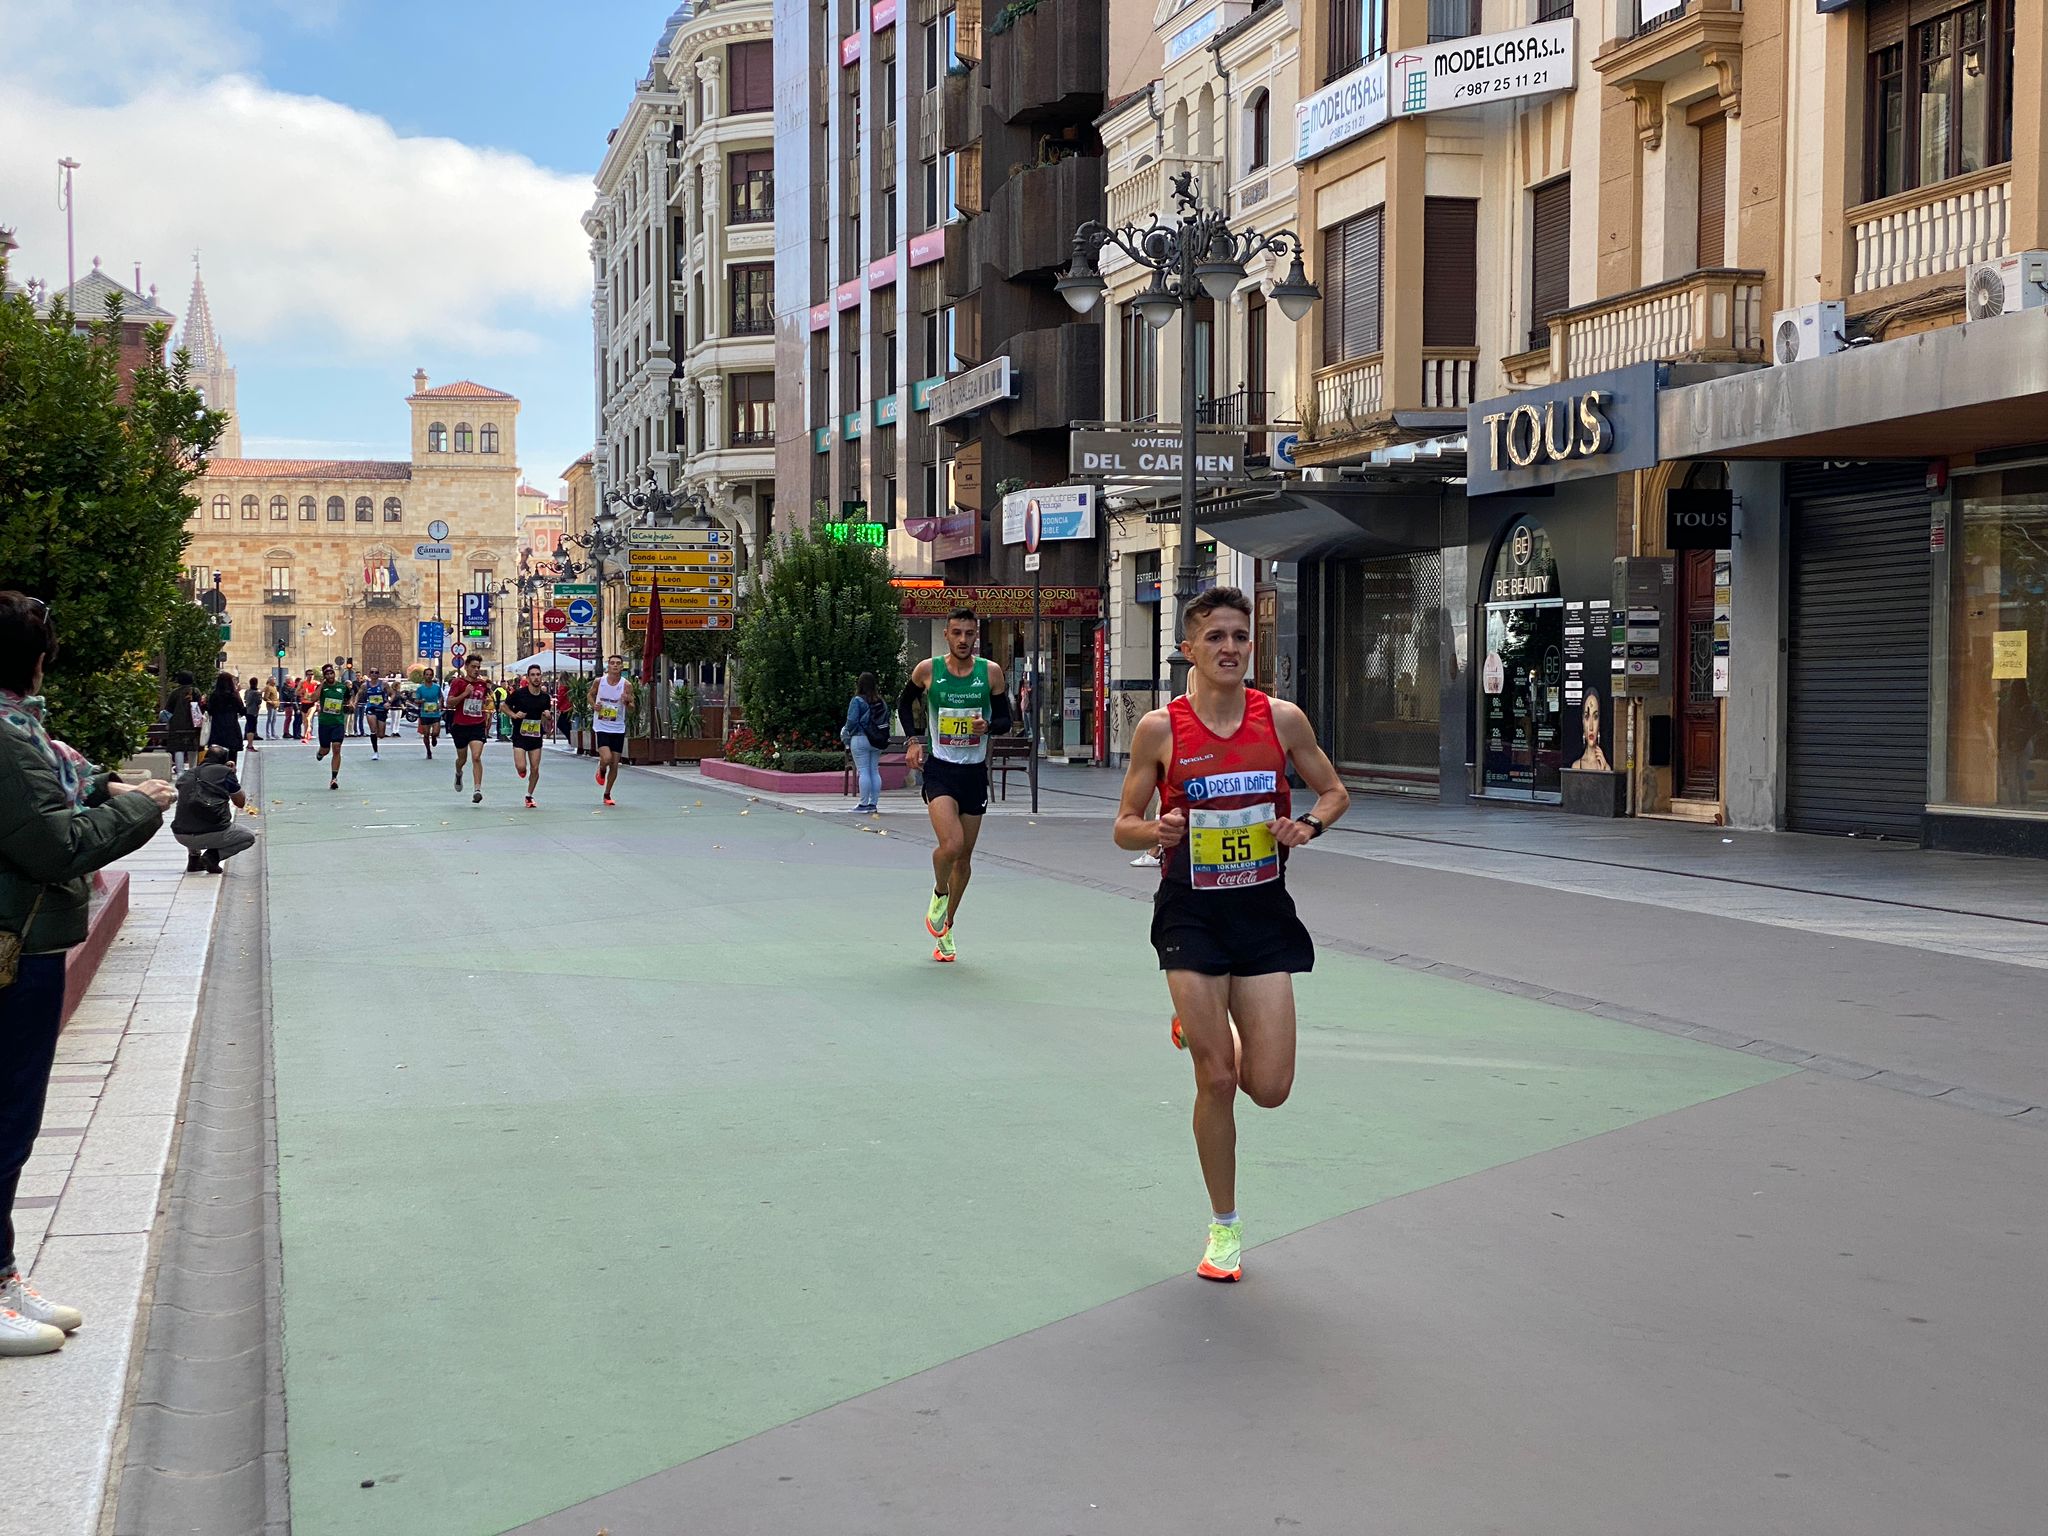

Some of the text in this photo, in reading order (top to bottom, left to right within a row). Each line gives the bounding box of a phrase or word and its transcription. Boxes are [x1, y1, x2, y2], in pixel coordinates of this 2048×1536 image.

[1467, 71, 1548, 96] 987 25 11 21
[1344, 122, 1351, 134] 25
[1352, 118, 1358, 130] 11
[1359, 114, 1365, 127] 21
[1483, 390, 1608, 471] TOUS
[1084, 453, 1234, 472] DEL CAREN
[1673, 512, 1727, 526] TOUS
[1515, 537, 1529, 555] BE
[904, 588, 1076, 599] ROYAL TANDOORI
[1497, 576, 1550, 597] BE BEAUTY
[953, 721, 968, 735] 76
[1209, 774, 1274, 795] PRESA IBAÑEZ
[1222, 835, 1251, 862] 55
